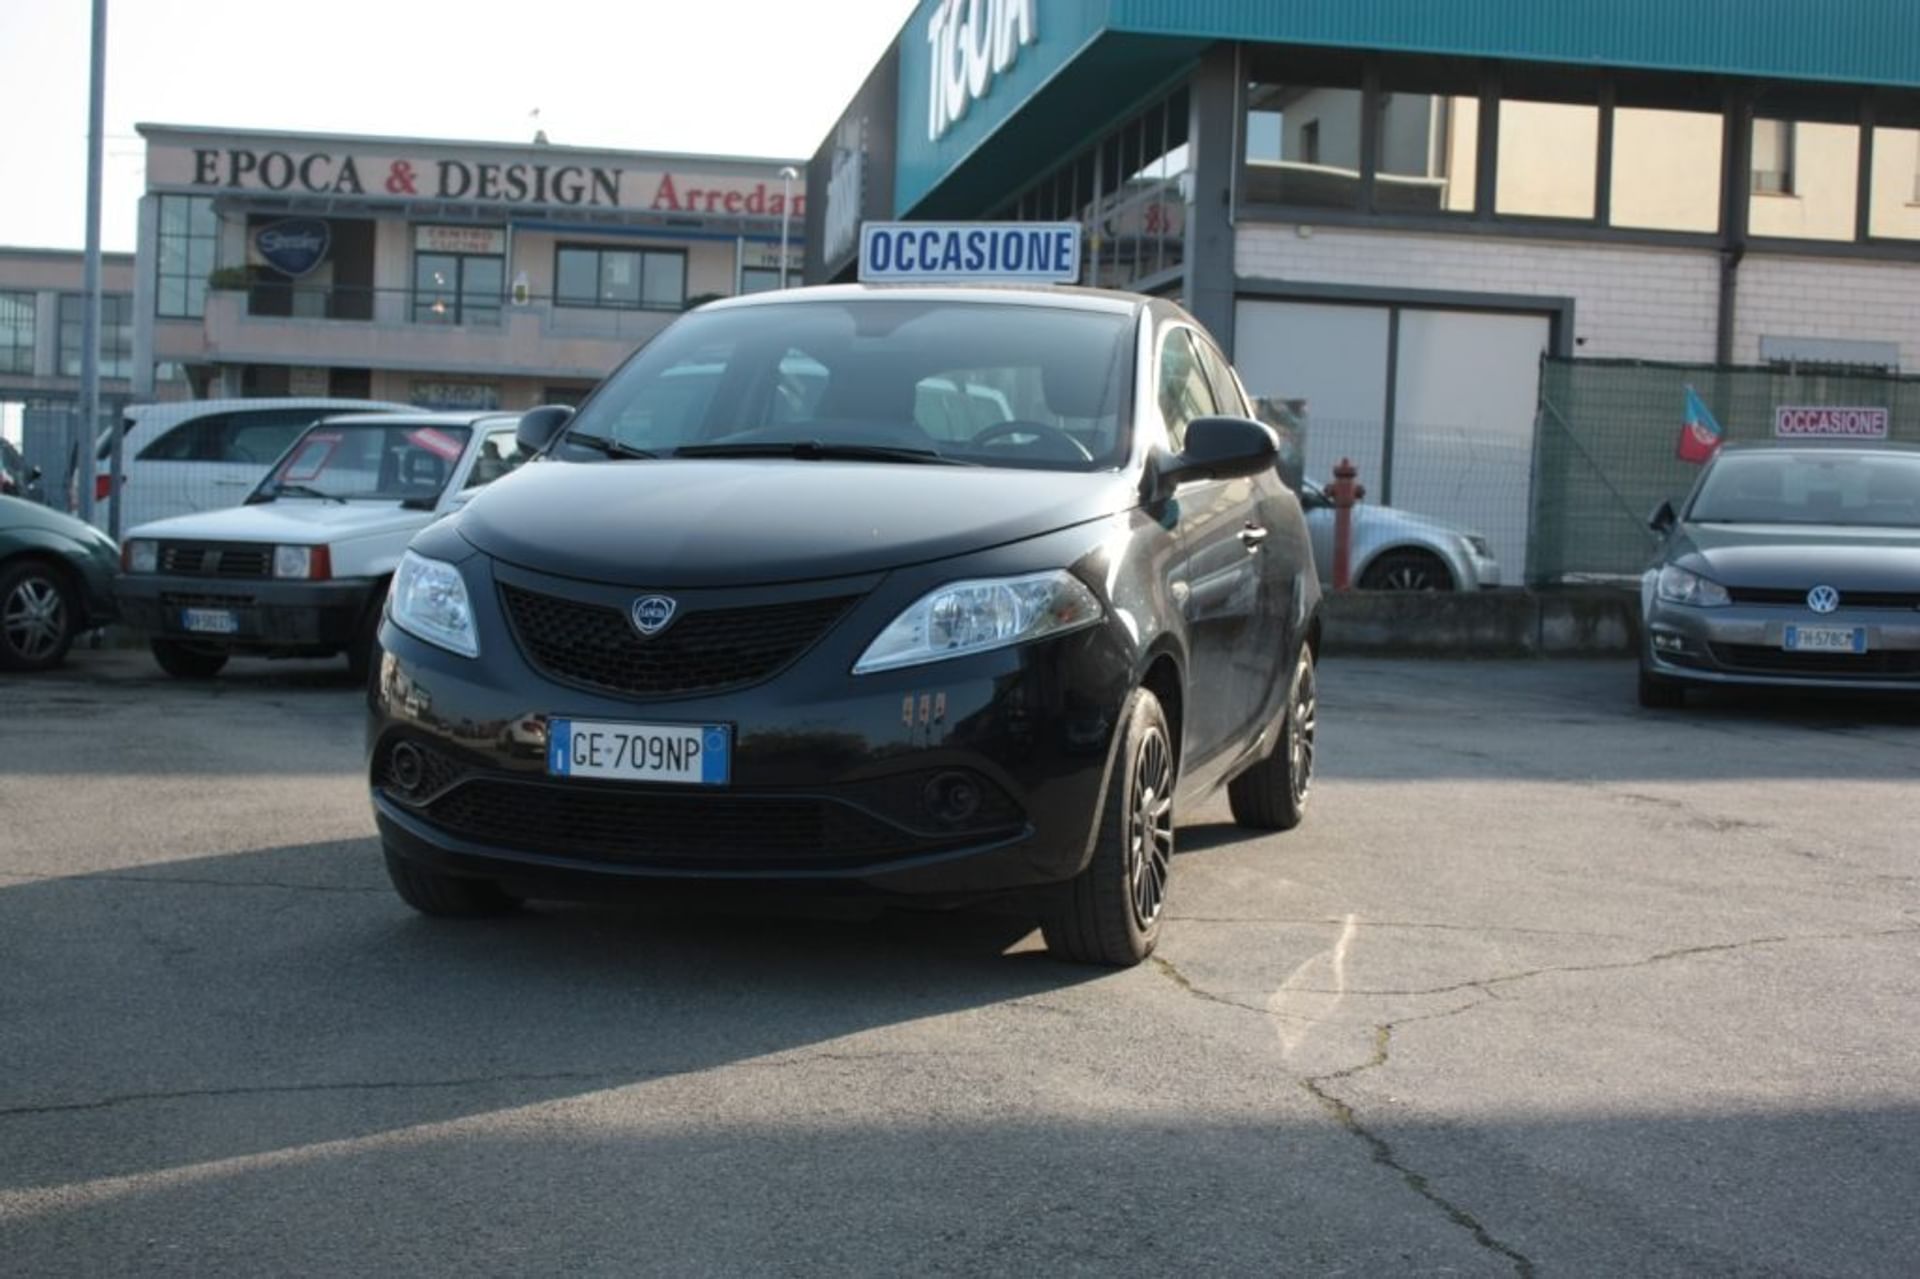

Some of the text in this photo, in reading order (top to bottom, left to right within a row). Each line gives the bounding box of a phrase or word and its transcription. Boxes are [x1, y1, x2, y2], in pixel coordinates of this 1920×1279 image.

[192, 149, 366, 195] EPOCA
[385, 160, 417, 195] &
[435, 160, 623, 207] DESIGN
[869, 230, 1073, 272] OCCASIONE
[1780, 411, 1884, 433] OCCASIONE
